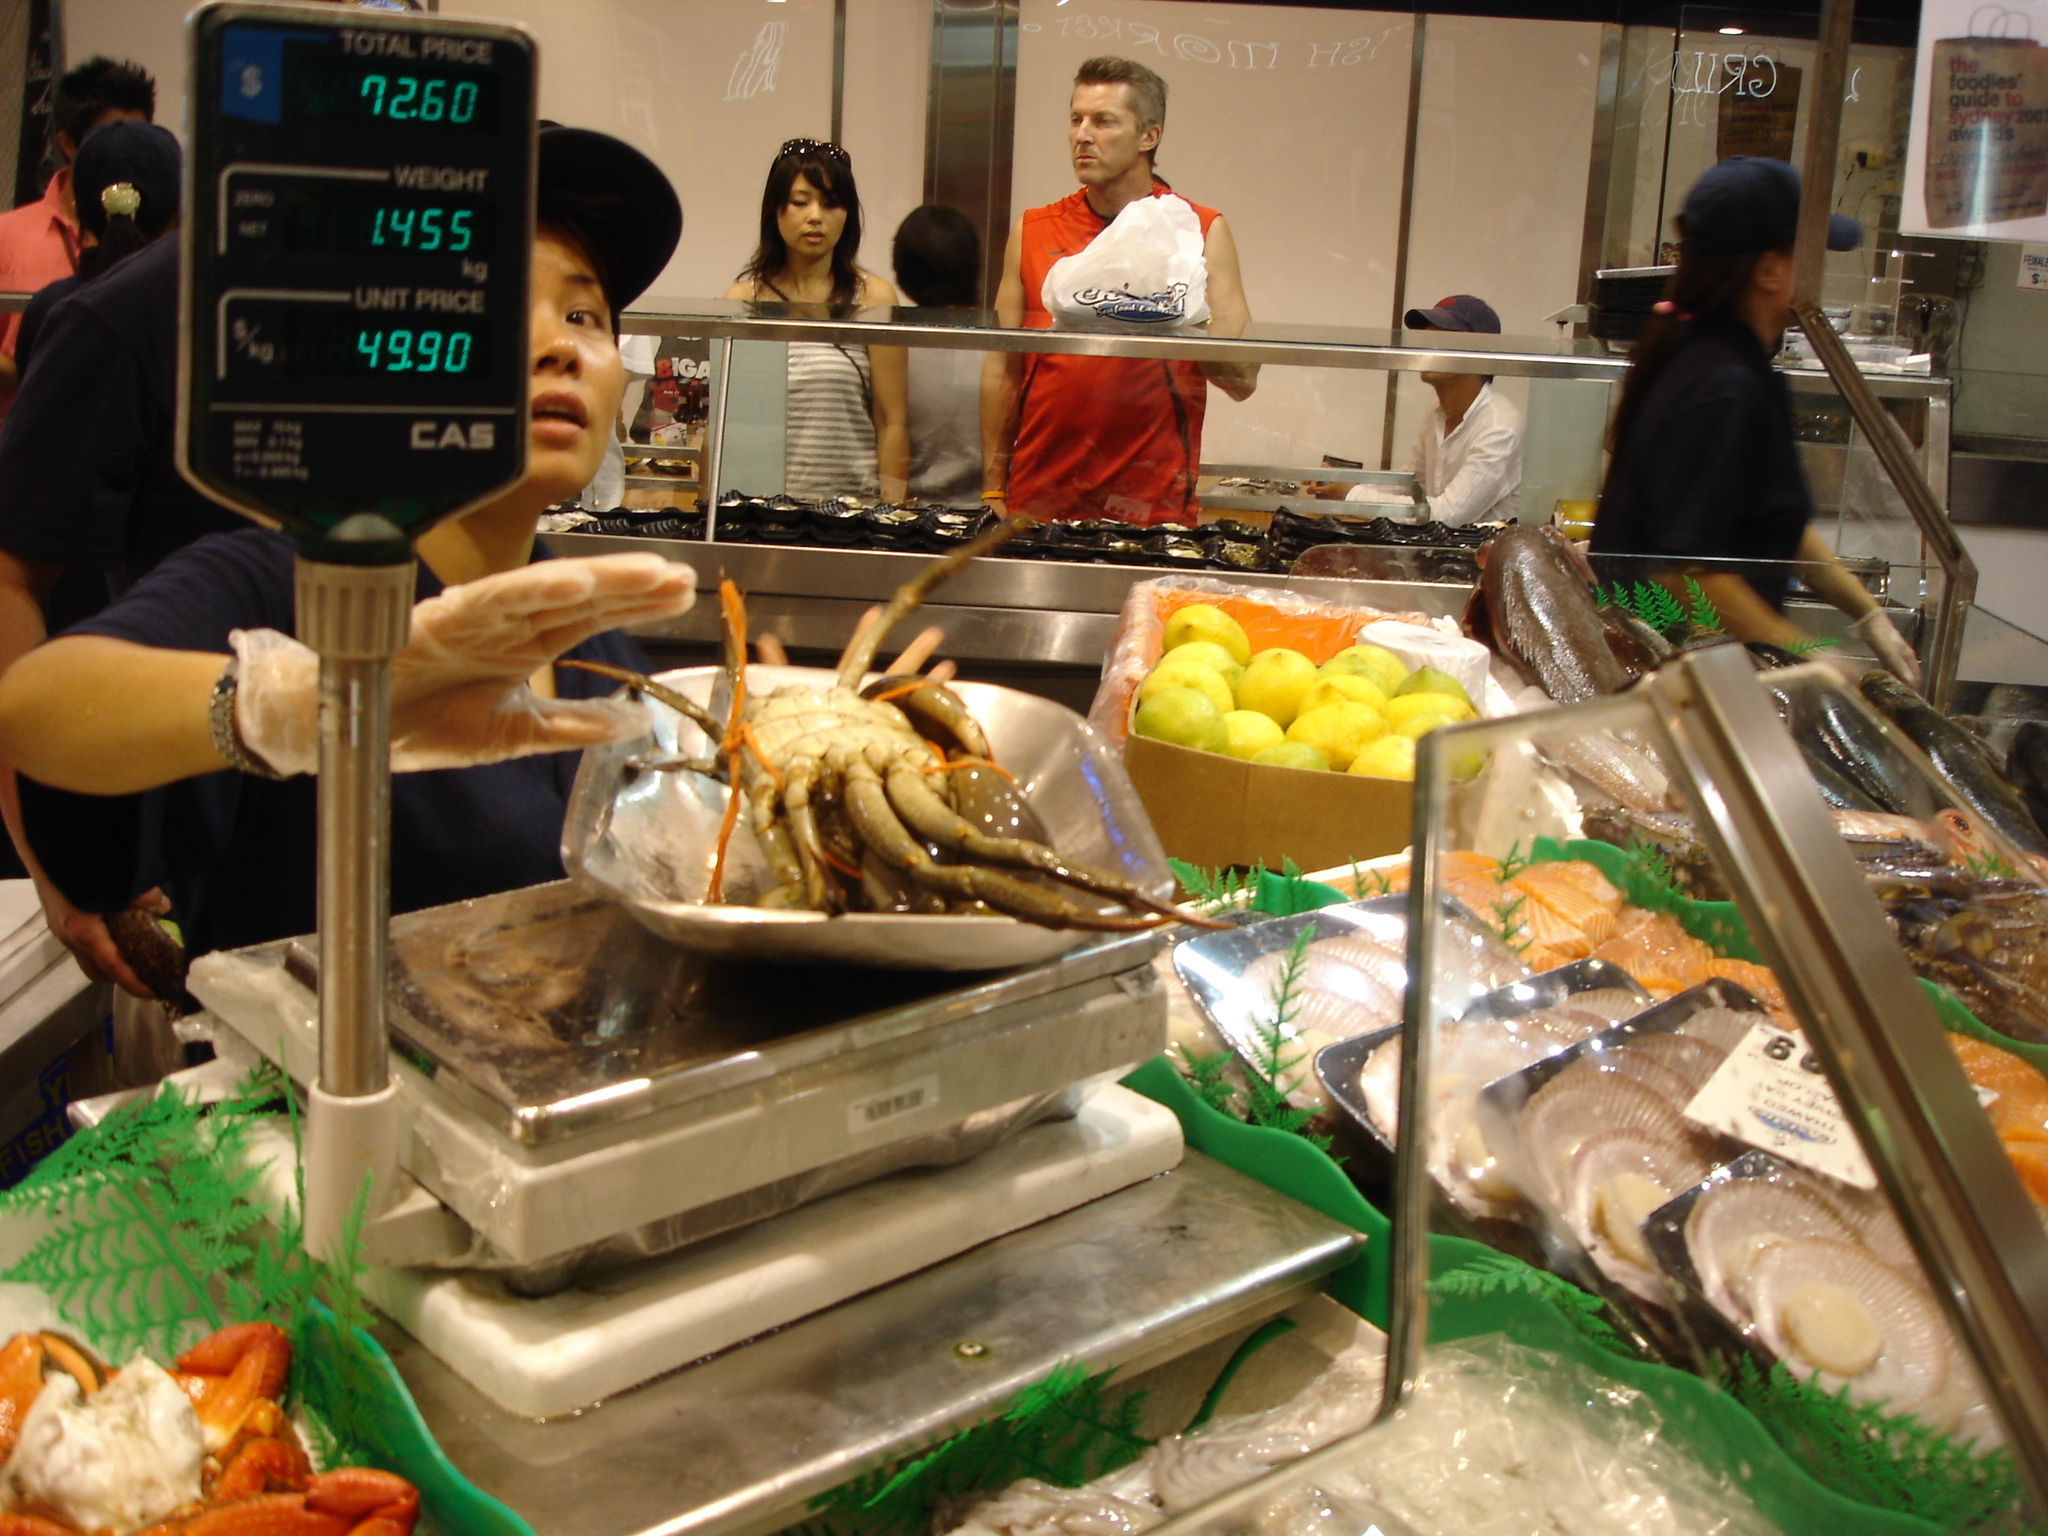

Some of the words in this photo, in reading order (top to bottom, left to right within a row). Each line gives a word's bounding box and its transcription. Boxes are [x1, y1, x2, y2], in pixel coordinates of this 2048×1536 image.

[340, 30, 417, 56] TOTAL
[421, 36, 494, 65] PRICE
[1949, 56, 1978, 73] the
[240, 64, 263, 99] $
[361, 75, 478, 123] 72.60
[1949, 91, 2000, 111] guide
[2004, 92, 2024, 107] to
[1948, 109, 2015, 128] sydney
[1949, 127, 2014, 141] awads
[394, 165, 489, 193] WEIGHT
[372, 208, 472, 250] 1.455
[462, 257, 488, 284] kg
[355, 286, 410, 310] UNIT
[414, 288, 486, 313] PRICE
[357, 330, 472, 372] 49.90
[411, 421, 495, 450] CAS
[0, 1116, 68, 1178] FISH
